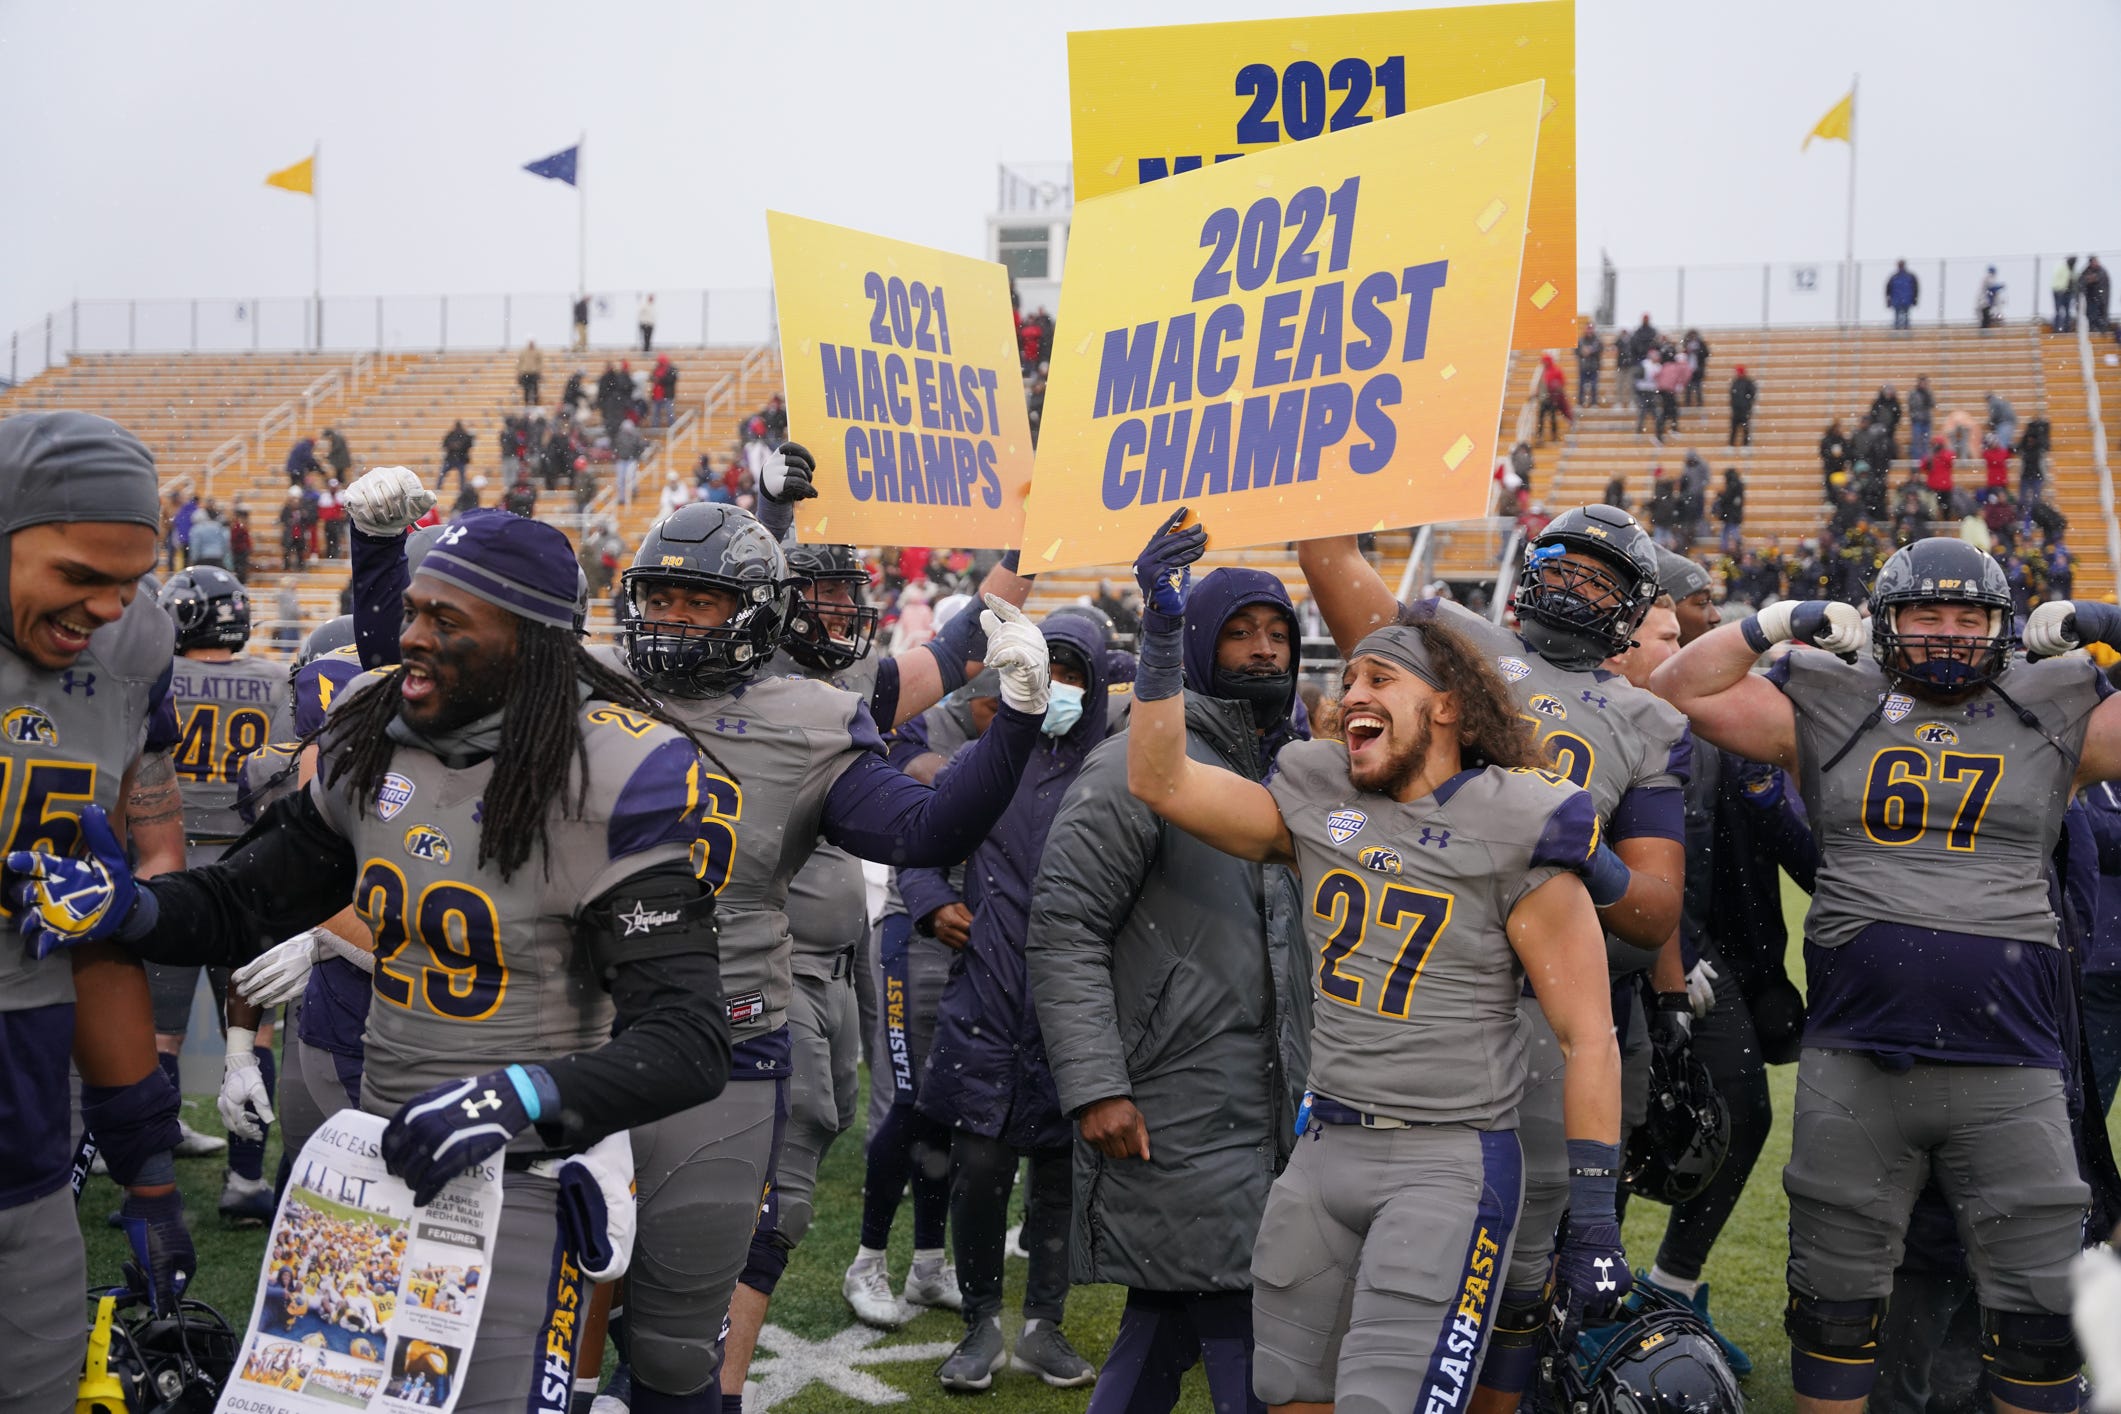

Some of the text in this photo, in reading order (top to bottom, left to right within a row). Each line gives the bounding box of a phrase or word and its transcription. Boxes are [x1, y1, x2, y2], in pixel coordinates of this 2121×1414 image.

[1235, 55, 1407, 145] 2021
[1191, 175, 1361, 303] 2021
[864, 271, 952, 356] 2021
[1092, 259, 1449, 420] MAC EAST
[819, 342, 1001, 437] MAC EAST
[844, 426, 1002, 510] CHAMPS
[1101, 373, 1403, 511] CHAMPS
[173, 676, 273, 702] SLATTERY
[1501, 661, 1531, 674] MAC
[172, 704, 271, 784] 48
[1328, 817, 1364, 831] MAC
[1861, 746, 2005, 852] 67
[353, 856, 509, 1021] 29
[634, 911, 680, 926] Douglas
[1313, 869, 1455, 1020] 27
[316, 1126, 348, 1148] MAC
[347, 1135, 380, 1158] EAS
[425, 1209, 484, 1229] REDHAWKS!
[427, 1227, 478, 1244] FEATURED
[428, 1200, 484, 1219] BEAT MIAMI
[227, 1396, 276, 1414] GOLDEN
